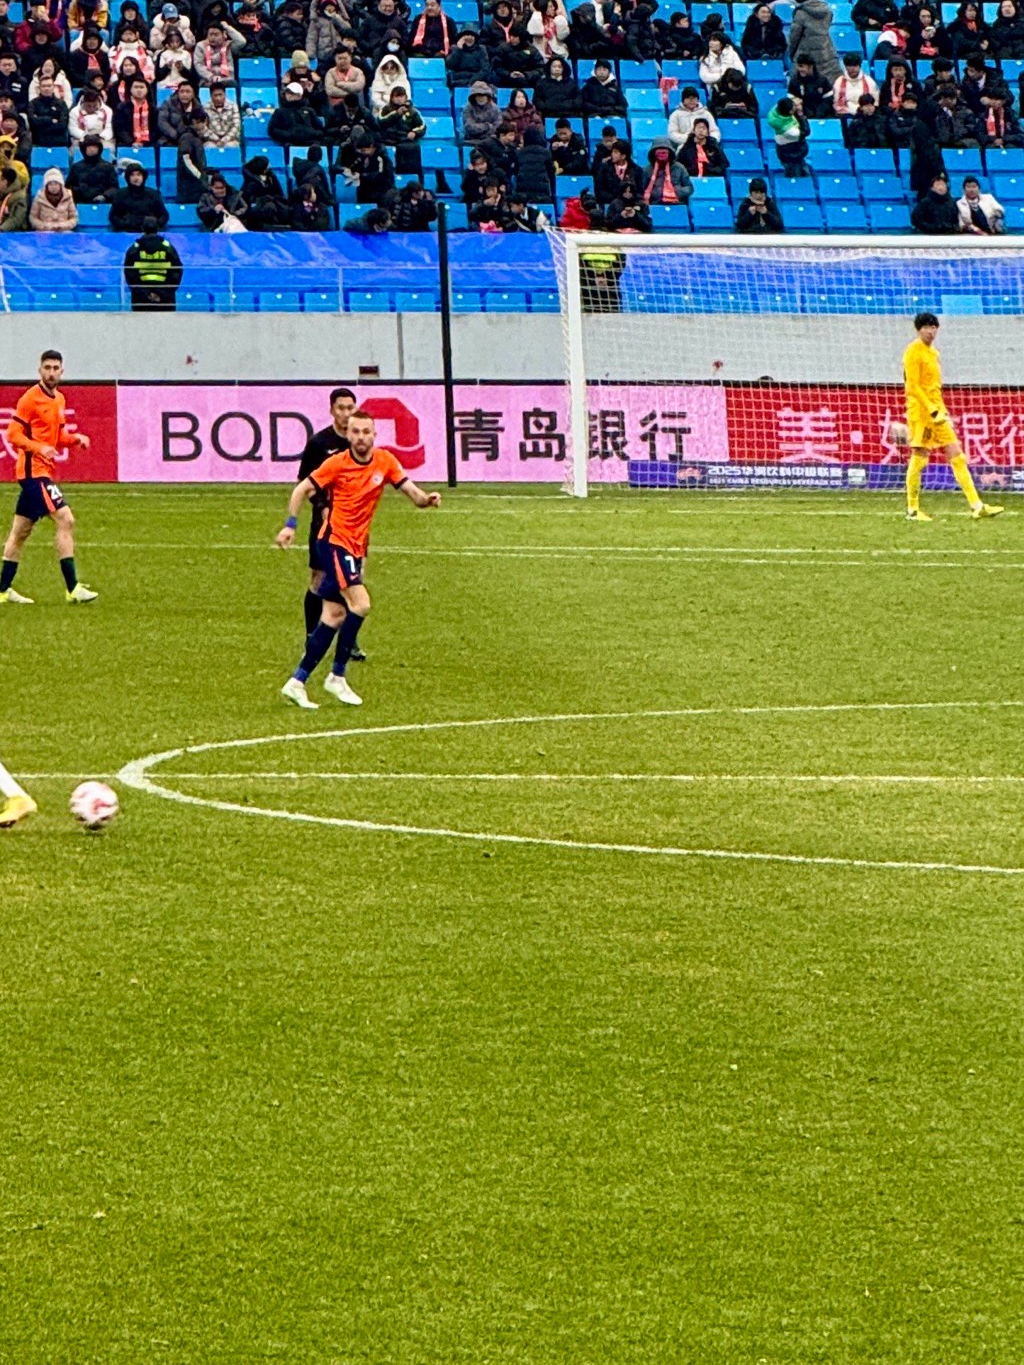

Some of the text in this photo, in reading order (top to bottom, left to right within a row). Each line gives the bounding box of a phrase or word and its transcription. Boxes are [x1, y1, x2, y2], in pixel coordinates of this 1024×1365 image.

[161, 411, 314, 463] BQD
[453, 408, 692, 463] 青岛银行
[344, 555, 356, 573] 7
